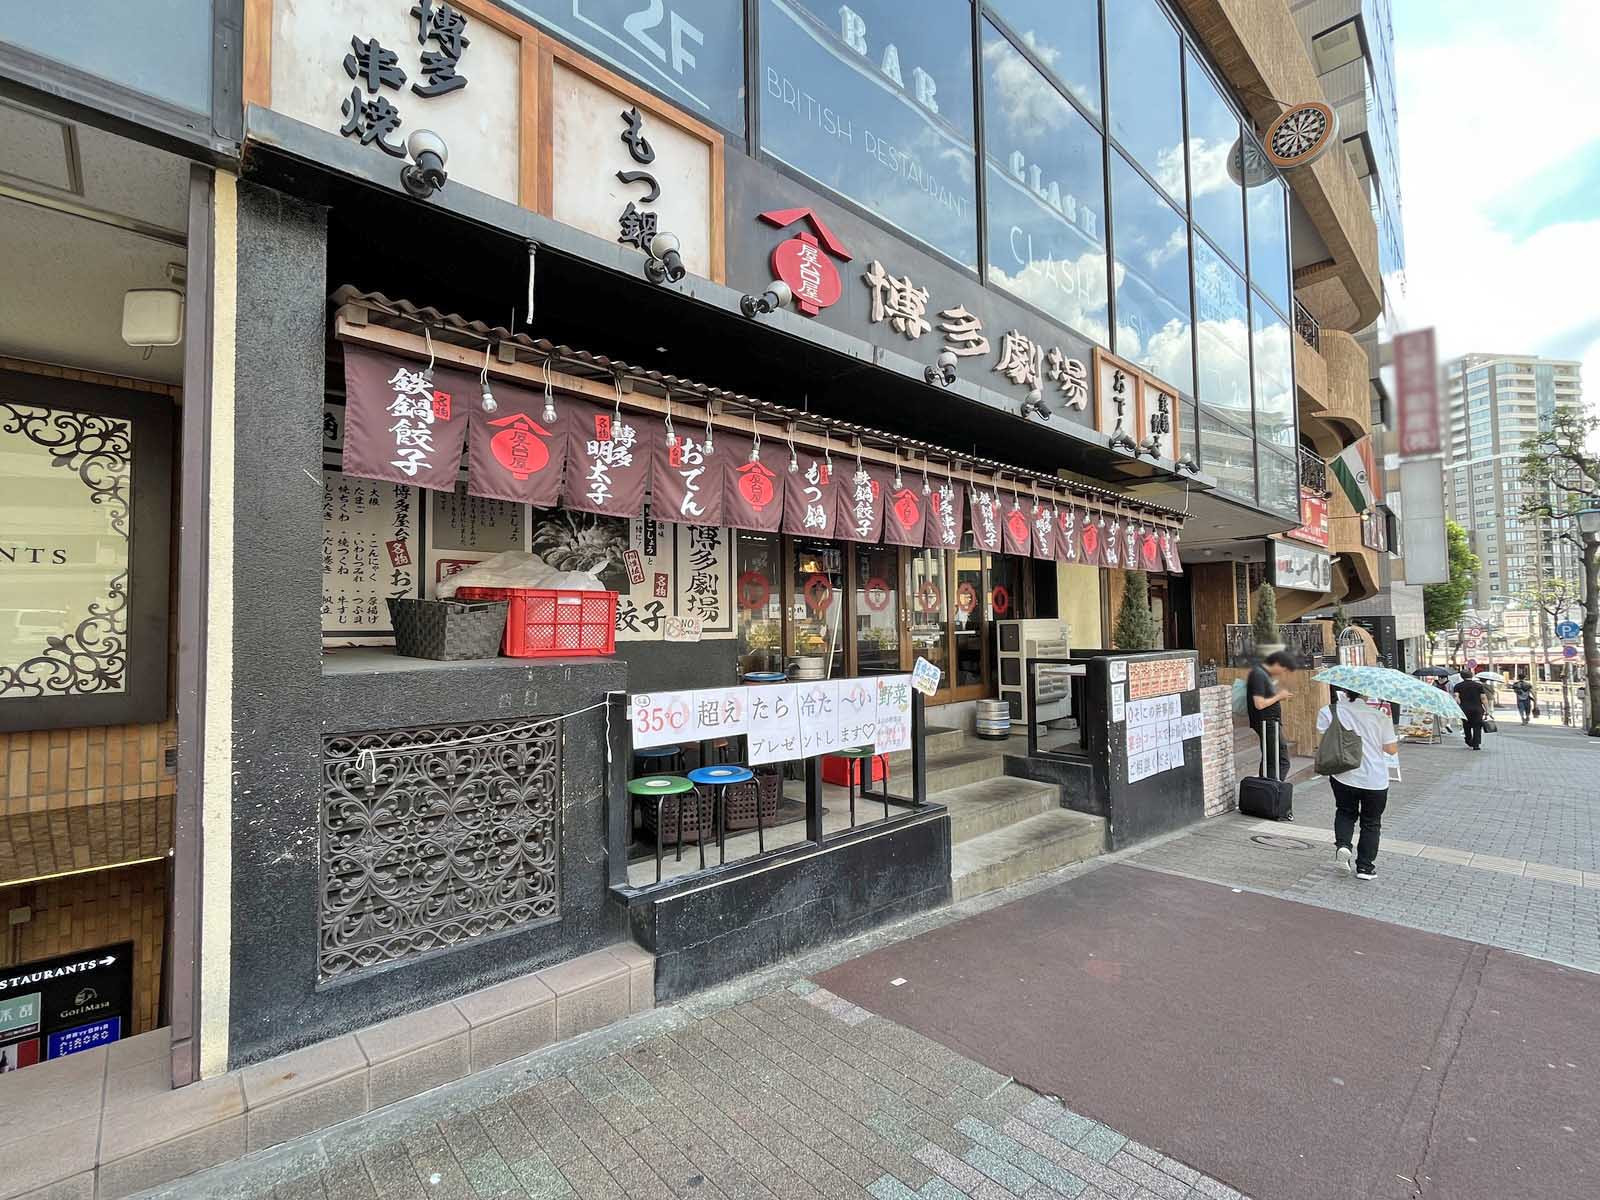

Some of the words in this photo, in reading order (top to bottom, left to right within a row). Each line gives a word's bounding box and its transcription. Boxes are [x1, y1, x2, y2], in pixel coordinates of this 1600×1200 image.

[410, 0, 471, 99] 博多
[624, 0, 704, 75] 2F
[838, 4, 938, 114] BAR
[341, 35, 408, 159] 串焼
[863, 260, 1090, 412] 博多劇場
[386, 367, 436, 477] 鉄鍋餃子
[586, 439, 615, 505] 明太子
[679, 437, 706, 517] おでん
[802, 460, 828, 530] もつ鍋
[686, 524, 722, 624] 博多劇場
